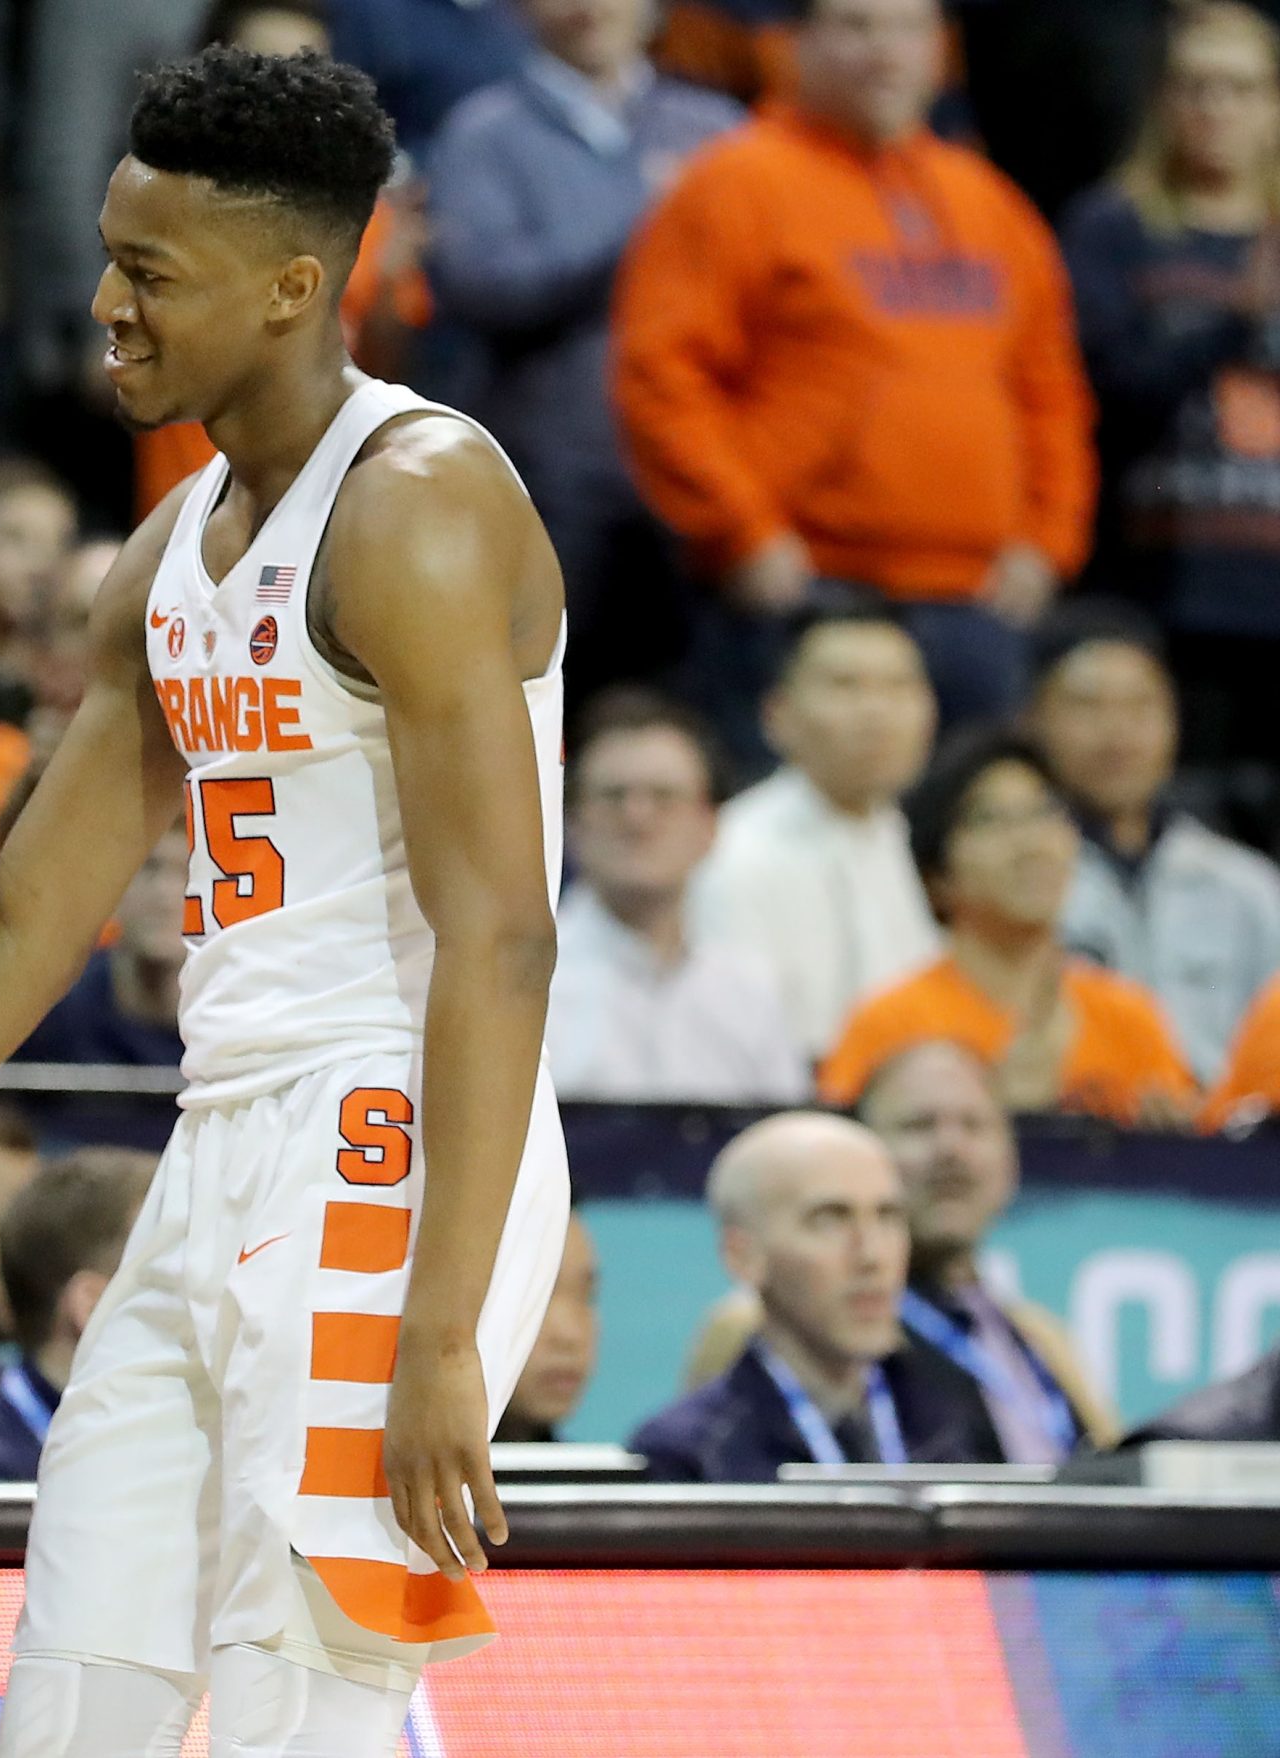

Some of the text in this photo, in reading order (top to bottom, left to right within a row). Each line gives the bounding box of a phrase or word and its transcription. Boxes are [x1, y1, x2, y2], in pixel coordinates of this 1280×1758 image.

[154, 676, 314, 753] RANGE
[182, 777, 285, 936] 5
[336, 1087, 414, 1187] S
